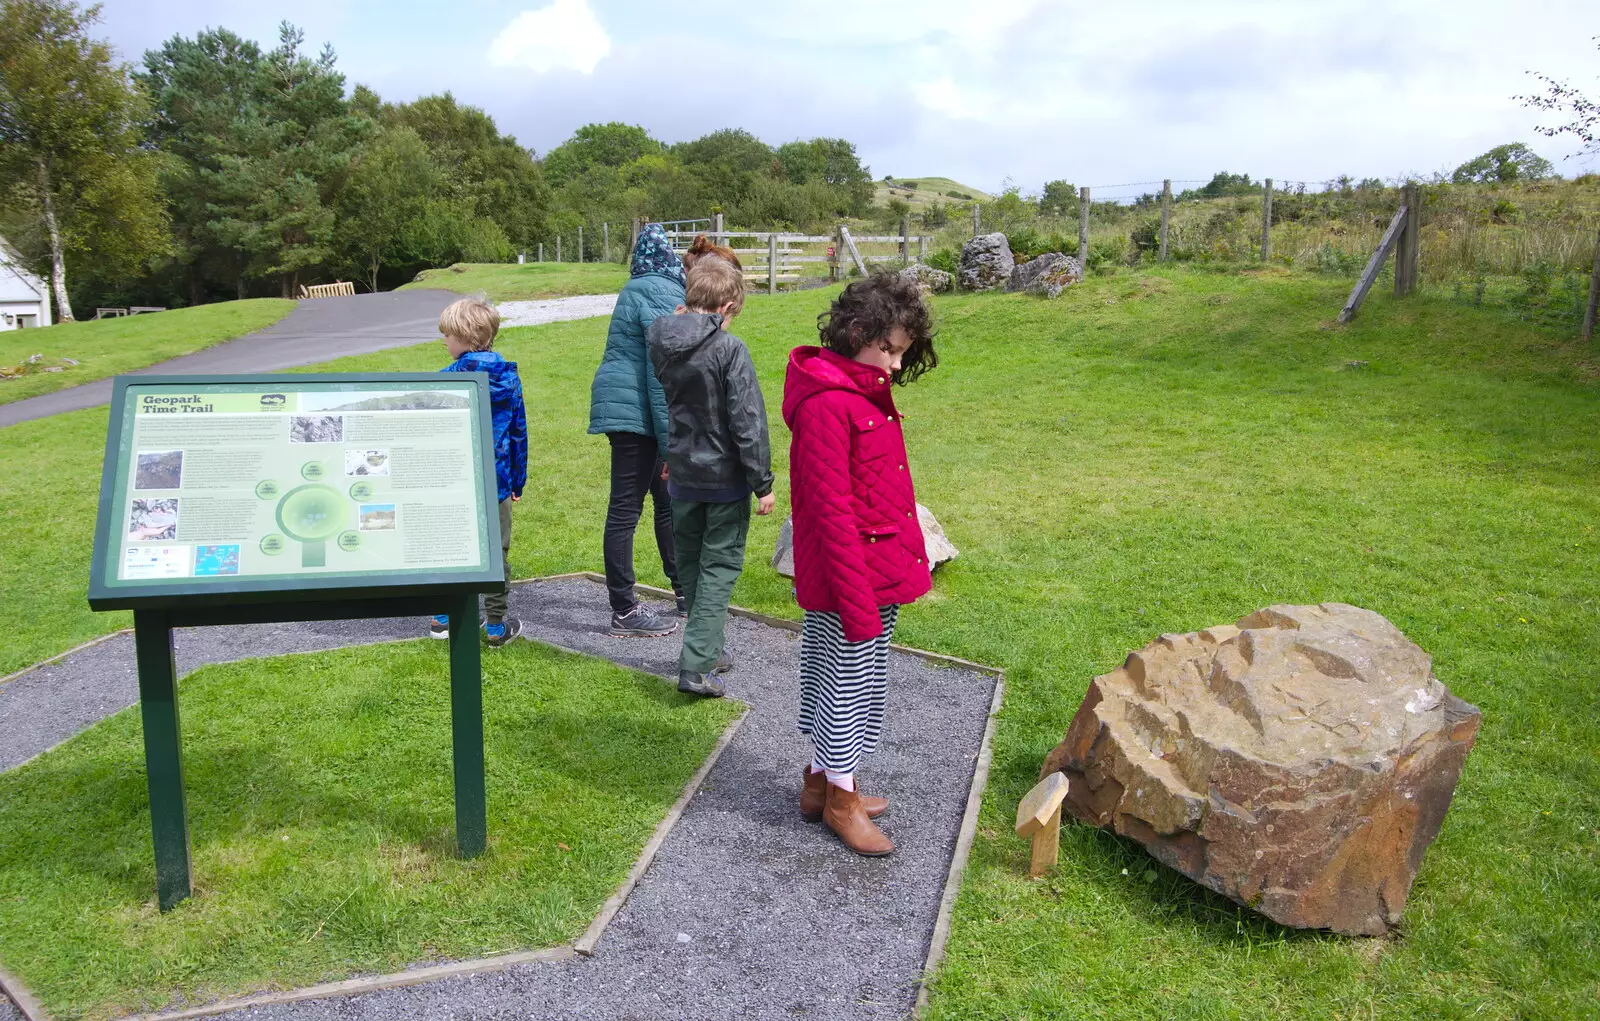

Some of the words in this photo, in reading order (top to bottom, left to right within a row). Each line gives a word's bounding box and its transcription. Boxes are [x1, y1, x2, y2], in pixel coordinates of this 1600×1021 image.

[144, 395, 201, 405] Geopark
[143, 405, 177, 413] Time
[181, 404, 213, 413] Trail
